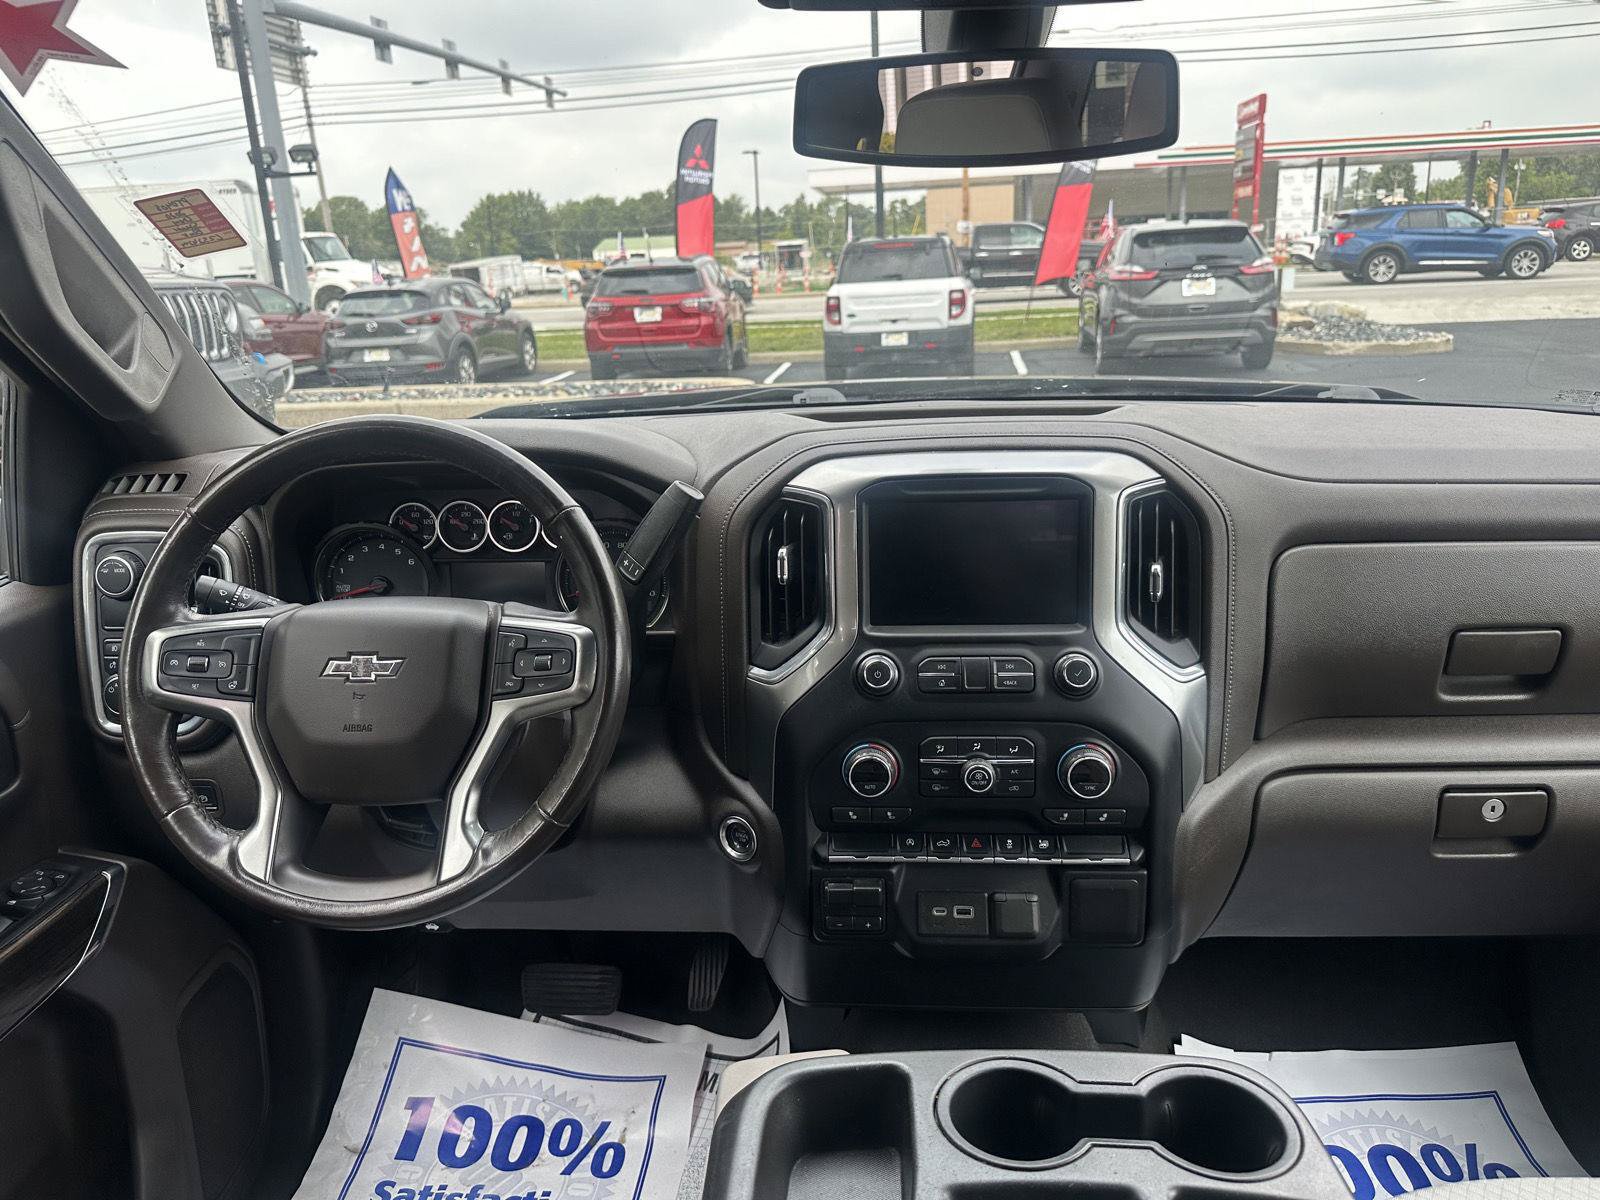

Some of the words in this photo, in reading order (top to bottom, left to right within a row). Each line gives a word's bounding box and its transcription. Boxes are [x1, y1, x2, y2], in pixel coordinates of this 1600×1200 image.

[361, 545, 369, 553] 3
[379, 543, 385, 551] 4
[347, 554, 355, 562] 2
[408, 558, 415, 566] 6
[342, 723, 374, 733] AIRBAG
[394, 1096, 627, 1179] 100%
